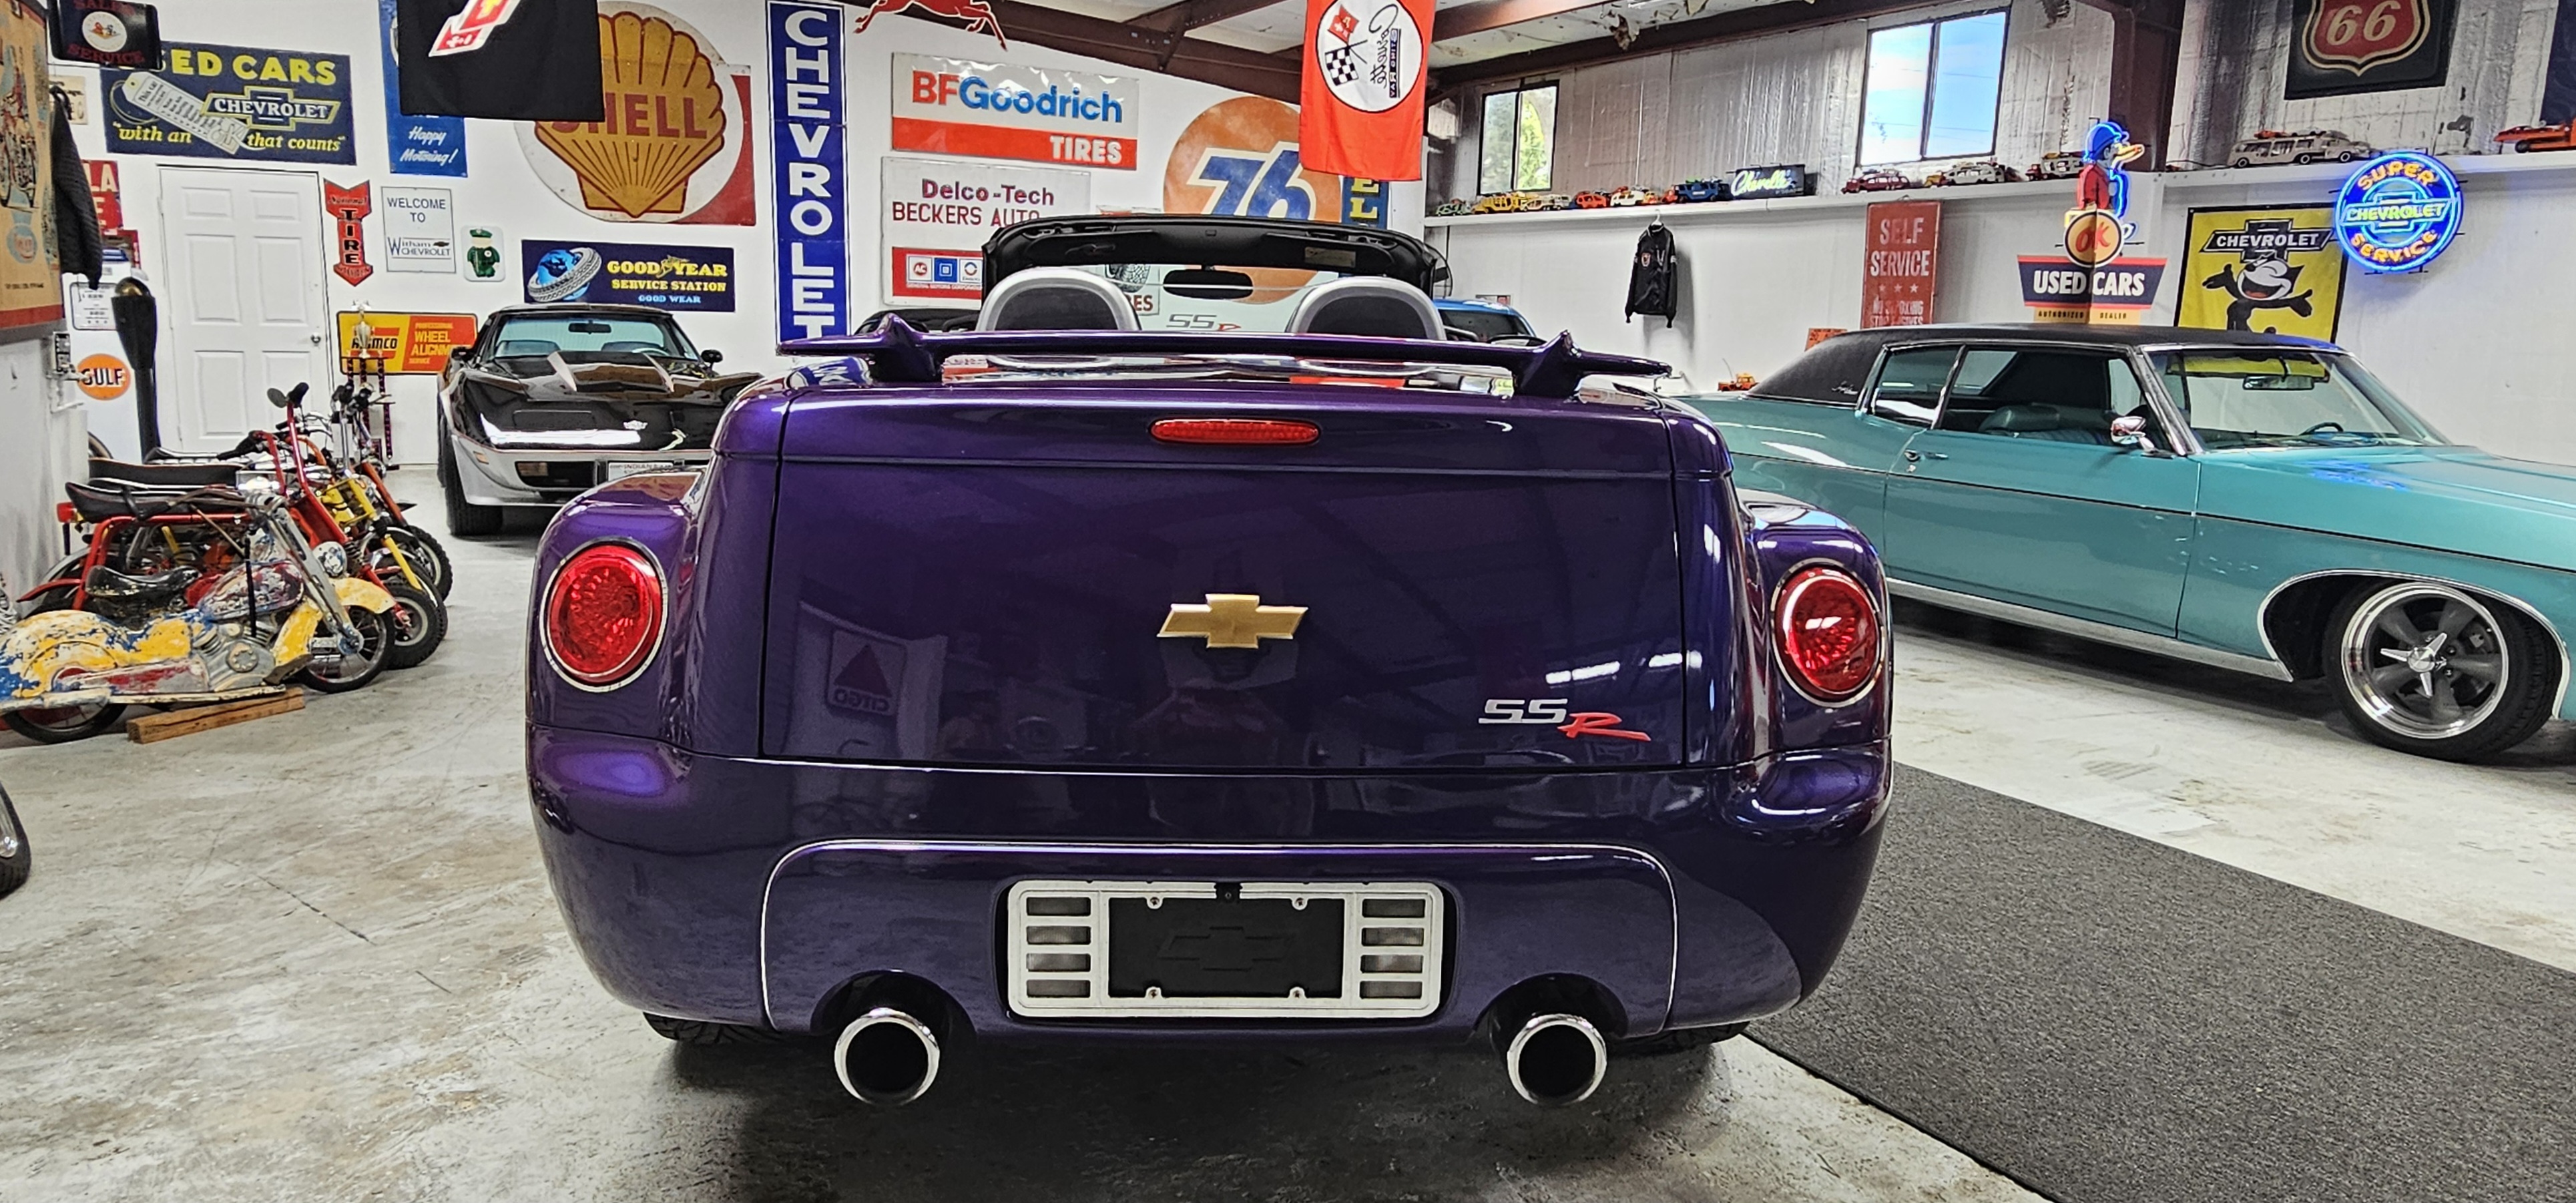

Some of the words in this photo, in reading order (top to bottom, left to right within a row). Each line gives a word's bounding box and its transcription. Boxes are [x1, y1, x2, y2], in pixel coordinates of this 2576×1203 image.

[2326, 0, 2401, 46] 66
[160, 49, 222, 75] ED
[232, 56, 336, 85] CARS
[214, 97, 328, 119] CHEVROLET
[912, 69, 1123, 123] BFGoodrich
[551, 92, 707, 139] HELL
[168, 132, 192, 144] an
[247, 132, 283, 148] that
[409, 126, 447, 146] Happy
[399, 148, 459, 166] Motoring!
[1049, 134, 1123, 165] TIRES
[785, 9, 834, 339] CHEVROLET
[1188, 142, 1315, 220] 76
[2357, 160, 2438, 191] SUPER
[387, 197, 447, 210] WELCOME
[892, 202, 982, 226] BECKERS
[2346, 203, 2446, 222] CHEVROLET
[410, 212, 426, 223] TO
[339, 208, 361, 265] TIRE
[1879, 218, 1924, 245] SELF
[2075, 221, 2111, 253] OK
[2216, 233, 2320, 248] CHEVROLET
[401, 248, 451, 256] CHEVROLET
[2351, 230, 2438, 262] SERVICE
[1870, 250, 1930, 277] SERVICE
[611, 278, 668, 290] SERVICE
[670, 280, 727, 292] STATION
[2033, 270, 2087, 294] USED
[2092, 271, 2145, 296] CARS
[638, 294, 667, 302] GOOD
[669, 295, 702, 304] WEAR
[2038, 310, 2085, 319] AUTHORIZED
[2099, 312, 2127, 320] DEALER
[351, 338, 399, 350] AMCO
[415, 330, 451, 342] WHEEL
[81, 368, 125, 388] GULF
[1478, 698, 1651, 742] SSR
